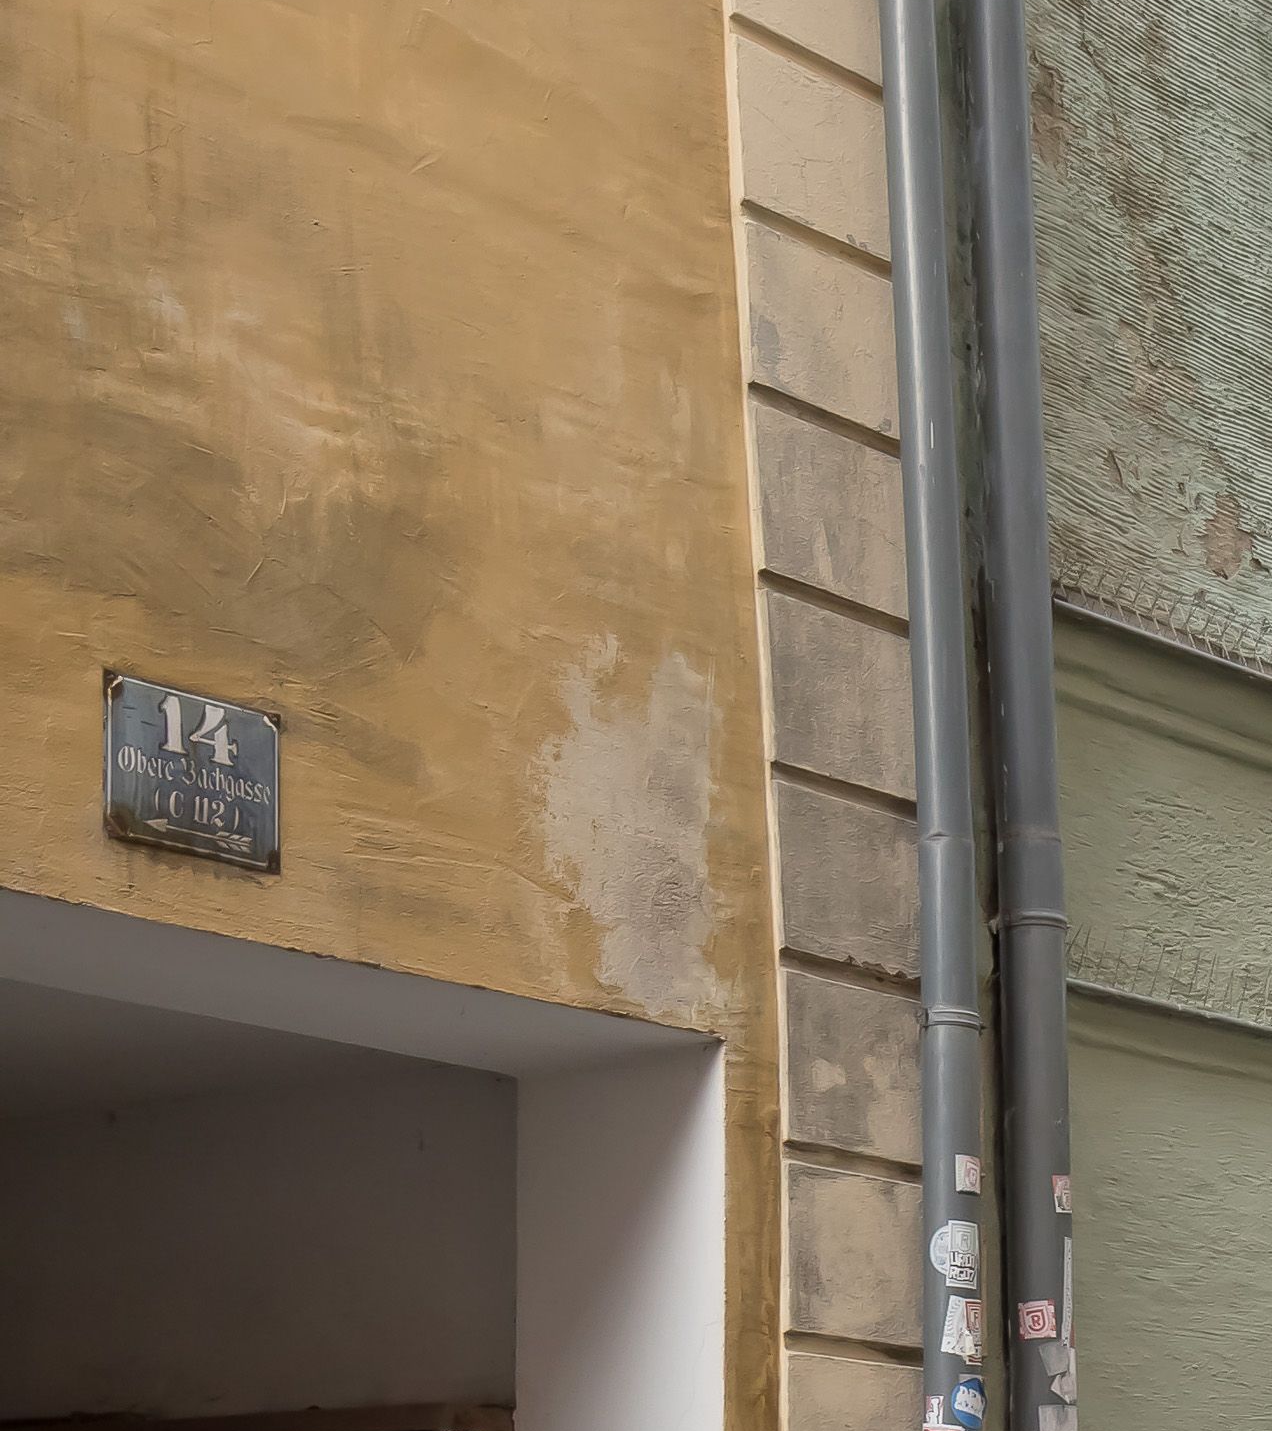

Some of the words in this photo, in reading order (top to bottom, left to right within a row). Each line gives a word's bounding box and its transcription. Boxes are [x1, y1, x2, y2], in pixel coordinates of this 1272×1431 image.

[158, 695, 238, 767] 14
[117, 745, 175, 781] Obere
[181, 757, 272, 805] Bachgasse
